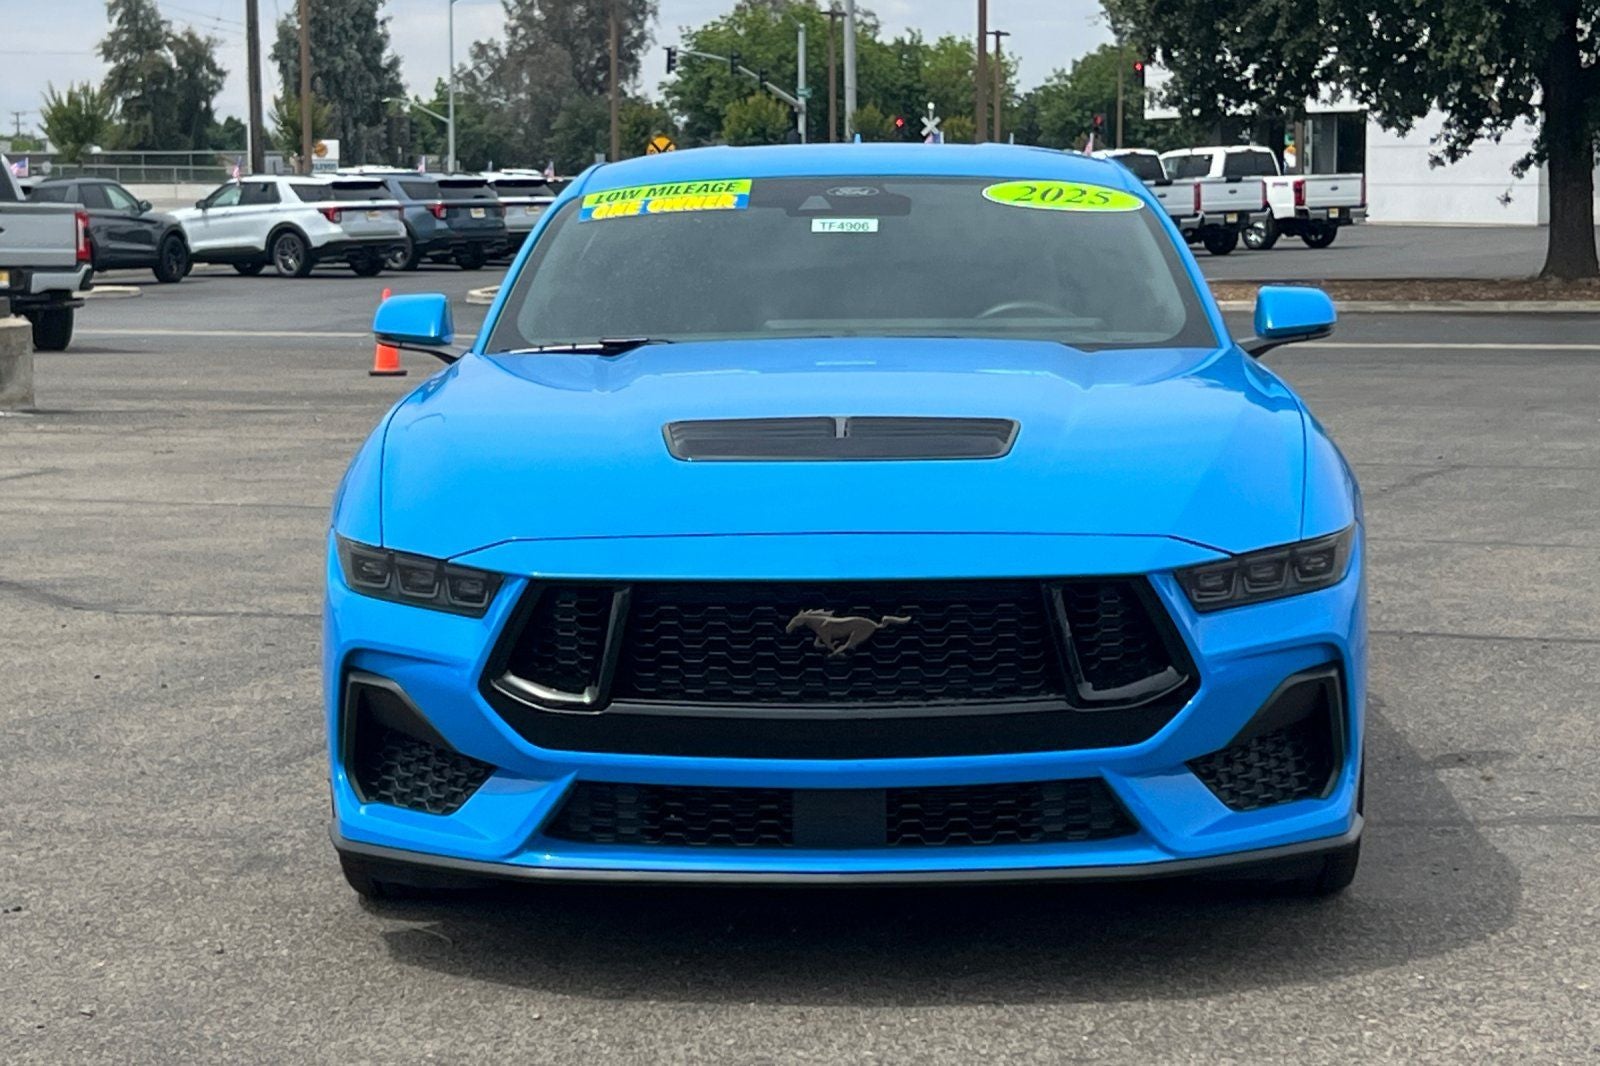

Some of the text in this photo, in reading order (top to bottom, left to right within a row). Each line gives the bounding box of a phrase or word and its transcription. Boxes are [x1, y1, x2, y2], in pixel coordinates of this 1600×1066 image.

[595, 182, 737, 204] LOW MILEAGE
[1014, 186, 1112, 205] 2025
[592, 195, 737, 219] ONE OWNER
[820, 222, 869, 231] TF4906
